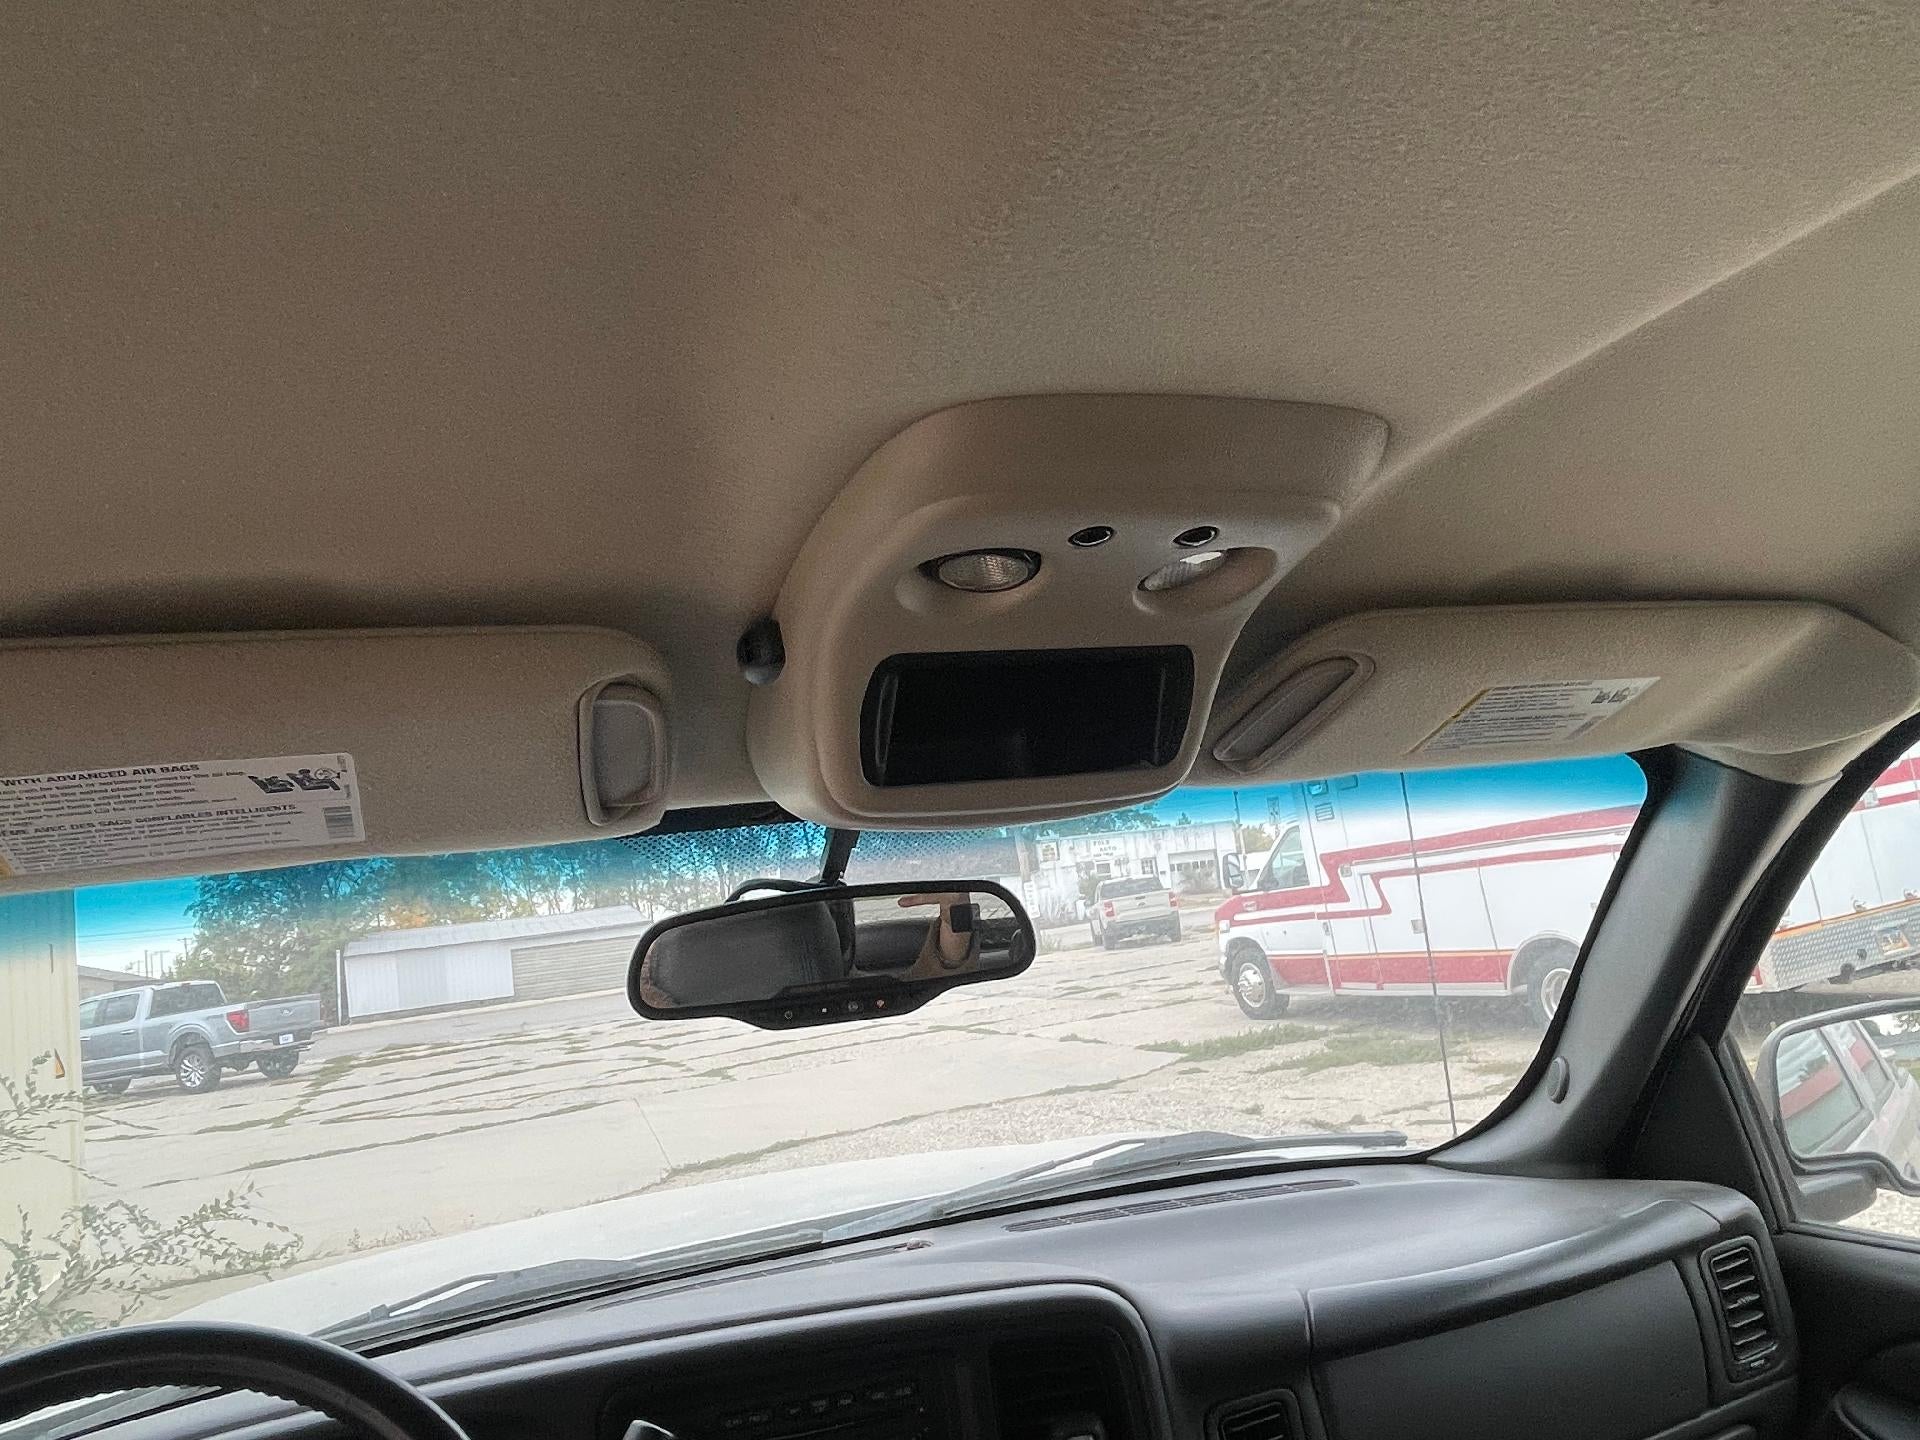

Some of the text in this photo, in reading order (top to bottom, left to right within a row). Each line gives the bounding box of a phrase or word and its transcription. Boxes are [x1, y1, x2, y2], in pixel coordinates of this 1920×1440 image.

[0, 764, 200, 787] WITH ADVANCED AIR BAGS
